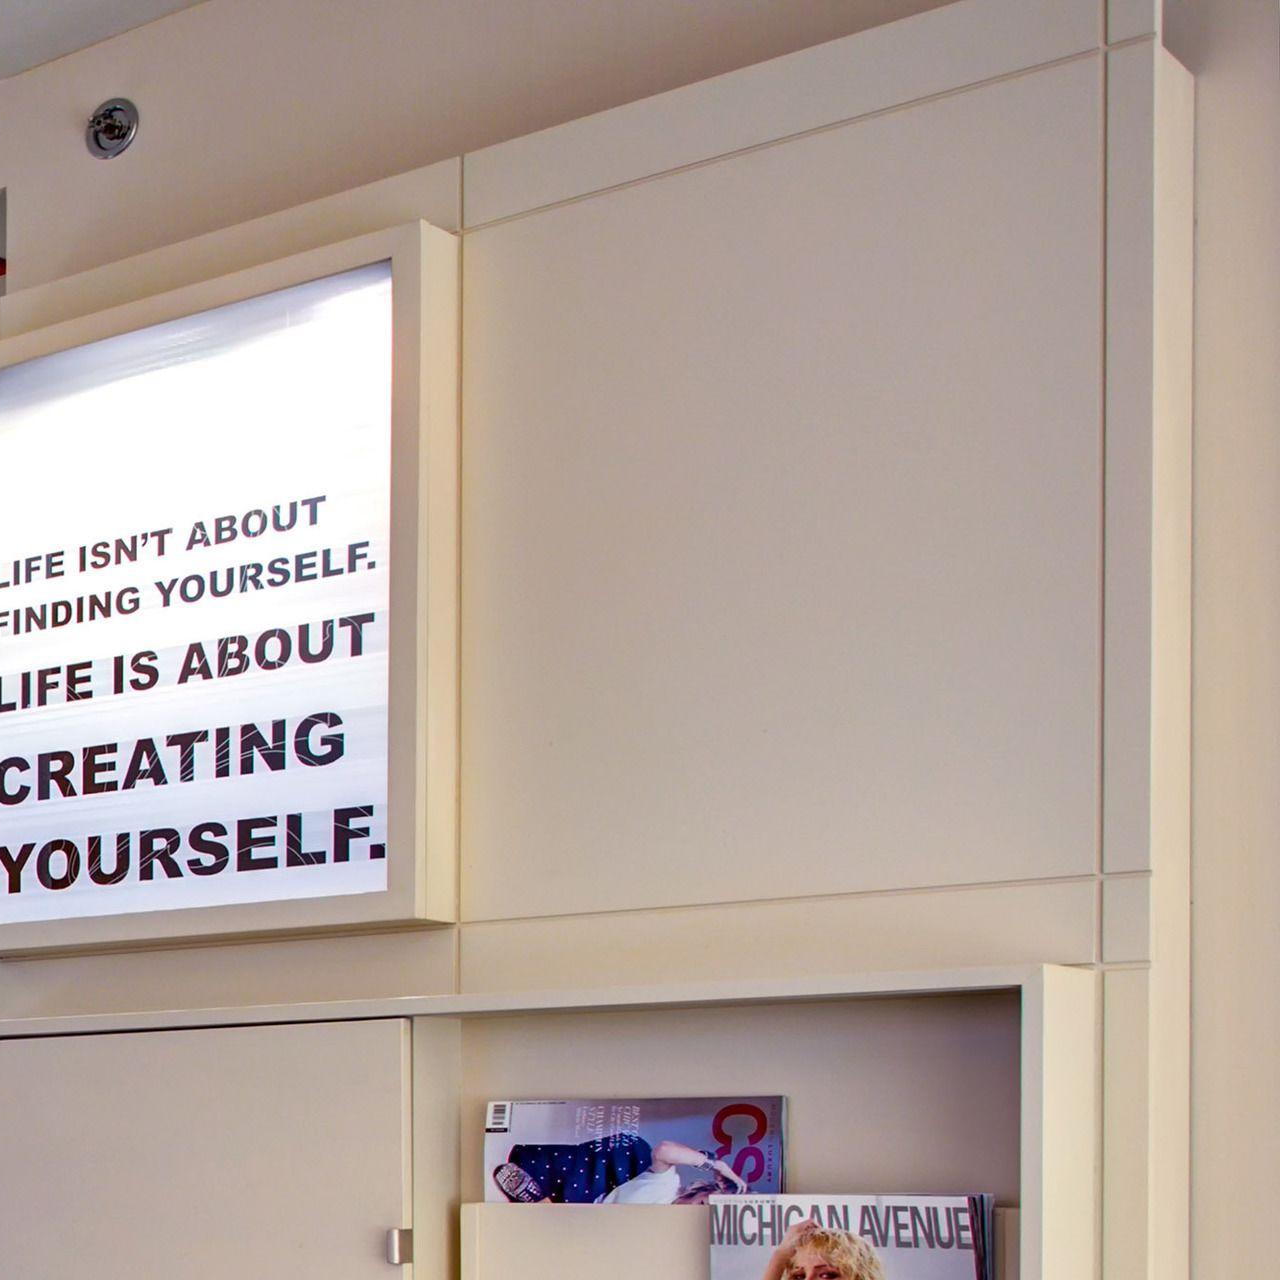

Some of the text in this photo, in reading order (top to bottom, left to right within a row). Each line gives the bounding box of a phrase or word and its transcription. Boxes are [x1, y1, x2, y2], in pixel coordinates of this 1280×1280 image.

[78, 527, 174, 572] ISN’T
[185, 495, 327, 552] ABOUT
[154, 541, 378, 608] YOURSELF.
[112, 649, 159, 695] IS
[177, 612, 376, 686] ABOUT
[712, 1103, 768, 1184] CS
[858, 1205, 975, 1249] AVENUE
